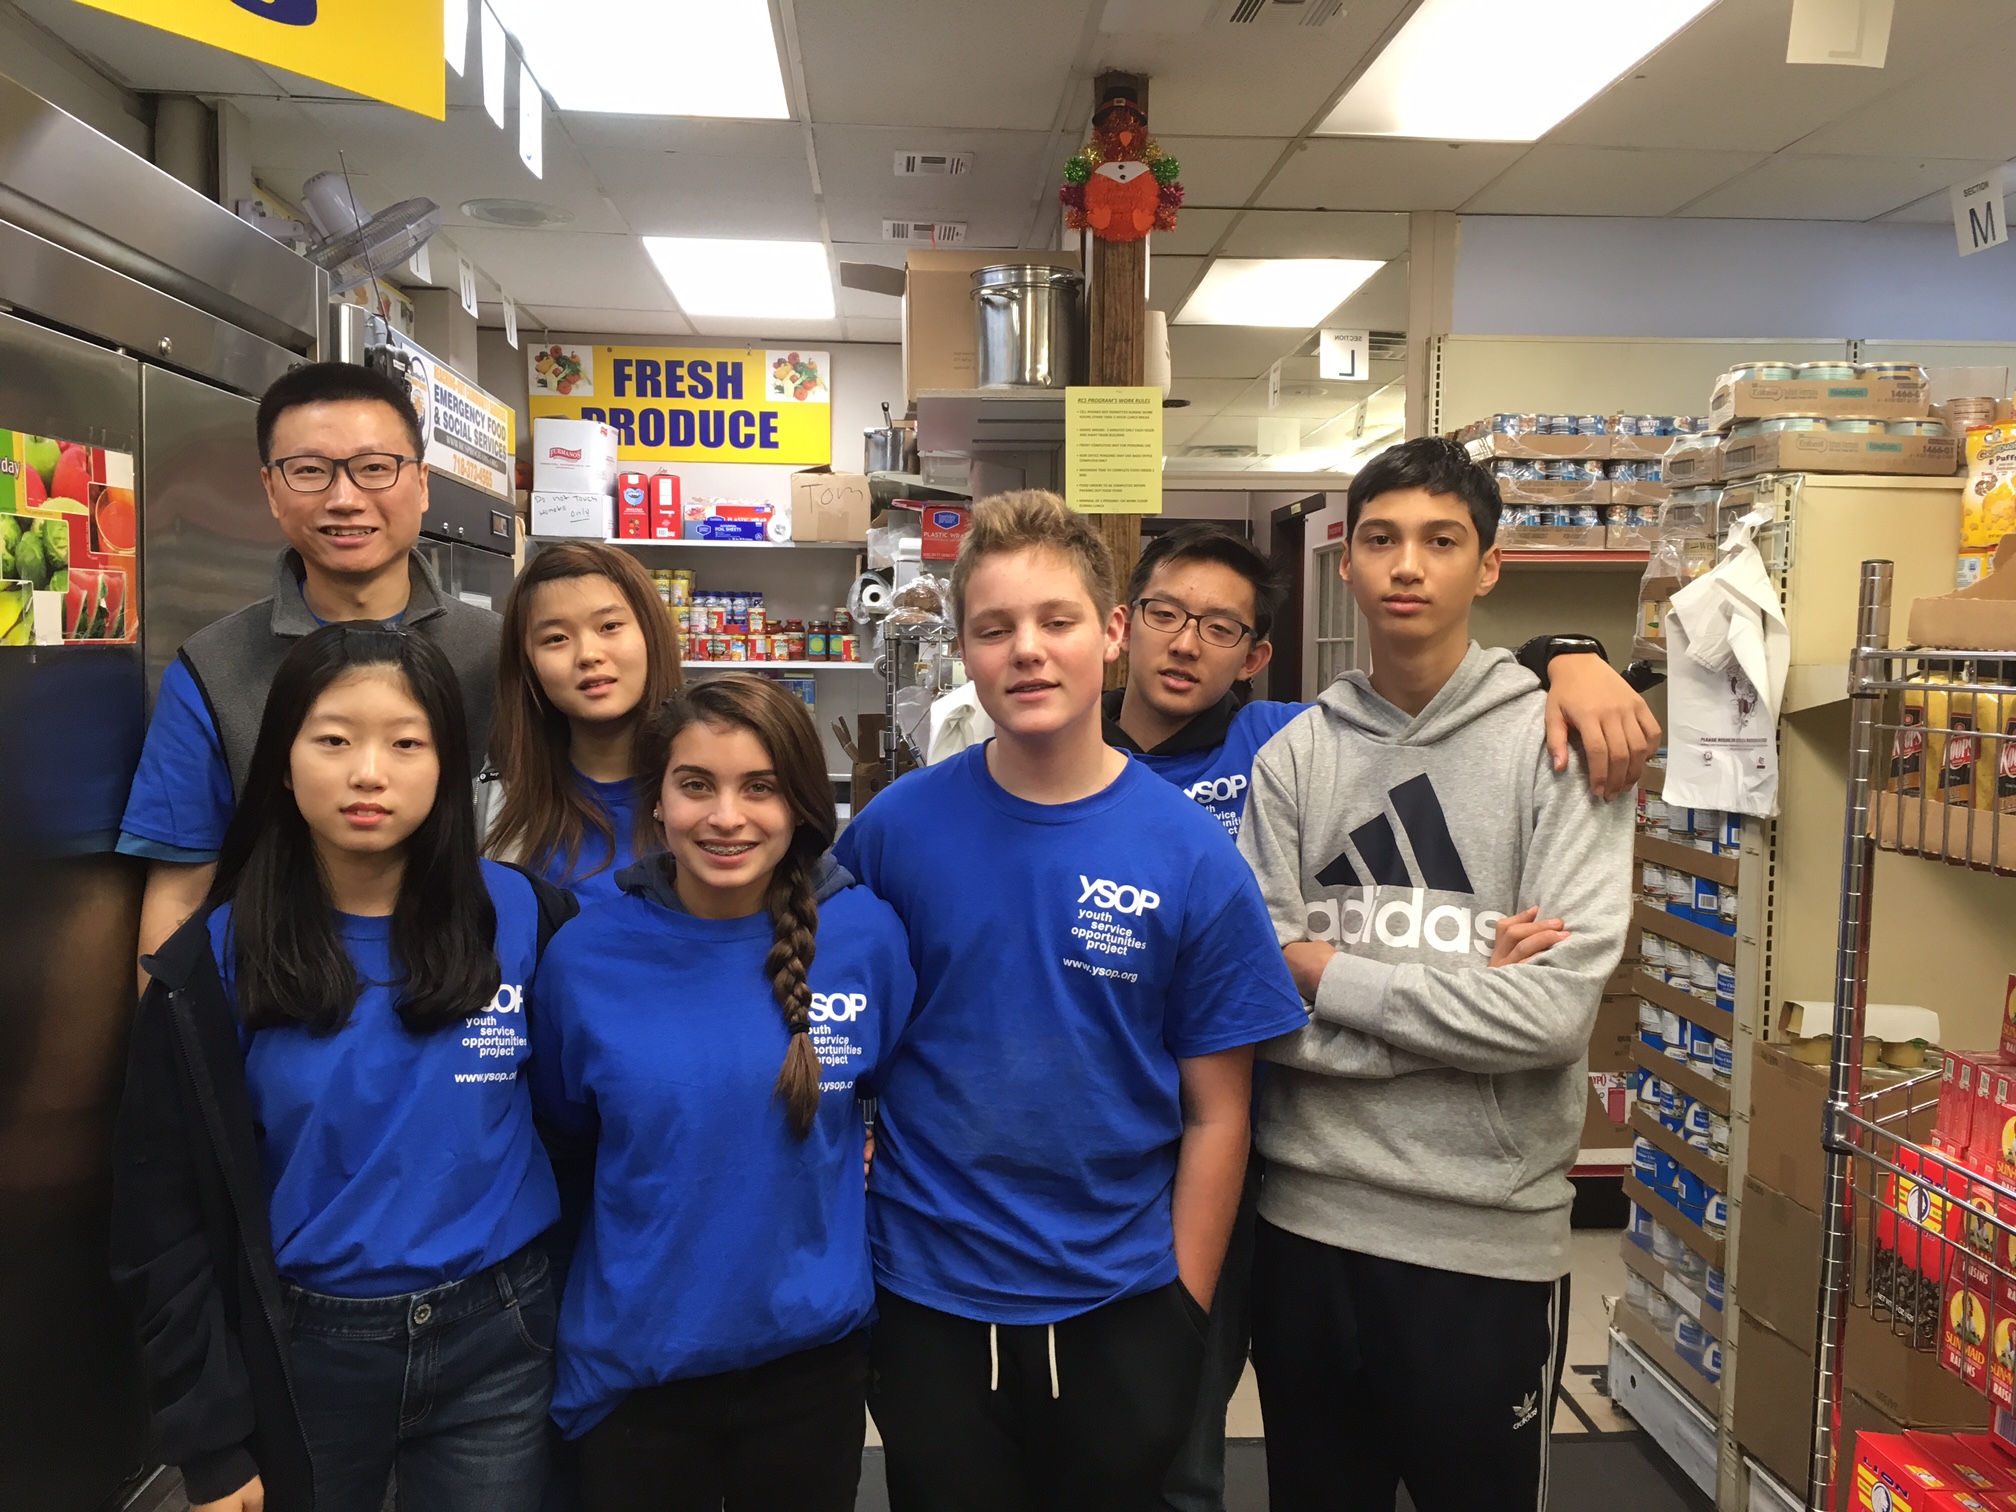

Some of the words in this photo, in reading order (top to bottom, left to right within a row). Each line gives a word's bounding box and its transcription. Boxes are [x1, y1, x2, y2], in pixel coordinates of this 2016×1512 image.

[1963, 181, 1989, 197] SECTION
[1969, 201, 1996, 248] M
[613, 358, 743, 400] FRESH
[434, 384, 485, 429] EMERGENCY
[488, 416, 506, 442] FOOD
[434, 406, 440, 426] &
[443, 411, 472, 441] SOCIAL
[474, 428, 506, 461] SERVICES
[0, 455, 21, 480] day
[1077, 874, 1161, 917] YSOP
[1078, 908, 1113, 923] youth
[1305, 885, 1508, 958] adidas
[1071, 926, 1147, 950] opportunities
[1091, 920, 1133, 937] service
[1086, 940, 1128, 956] project
[1062, 957, 1138, 983] www.ysop.org
[808, 993, 867, 1022] SOP
[466, 1016, 497, 1029] youth
[480, 1026, 515, 1036] service
[808, 1025, 831, 1035] outh
[462, 1035, 527, 1048] opportunities
[480, 1046, 514, 1058] project
[813, 1035, 850, 1045] service
[1945, 1330, 1985, 1365] SUNMAID
[1949, 1351, 1976, 1378] RAIINS
[1993, 1382, 2012, 1405] RAISI
[1513, 1407, 1538, 1430] adidas
[1863, 1456, 1909, 1500] LION
